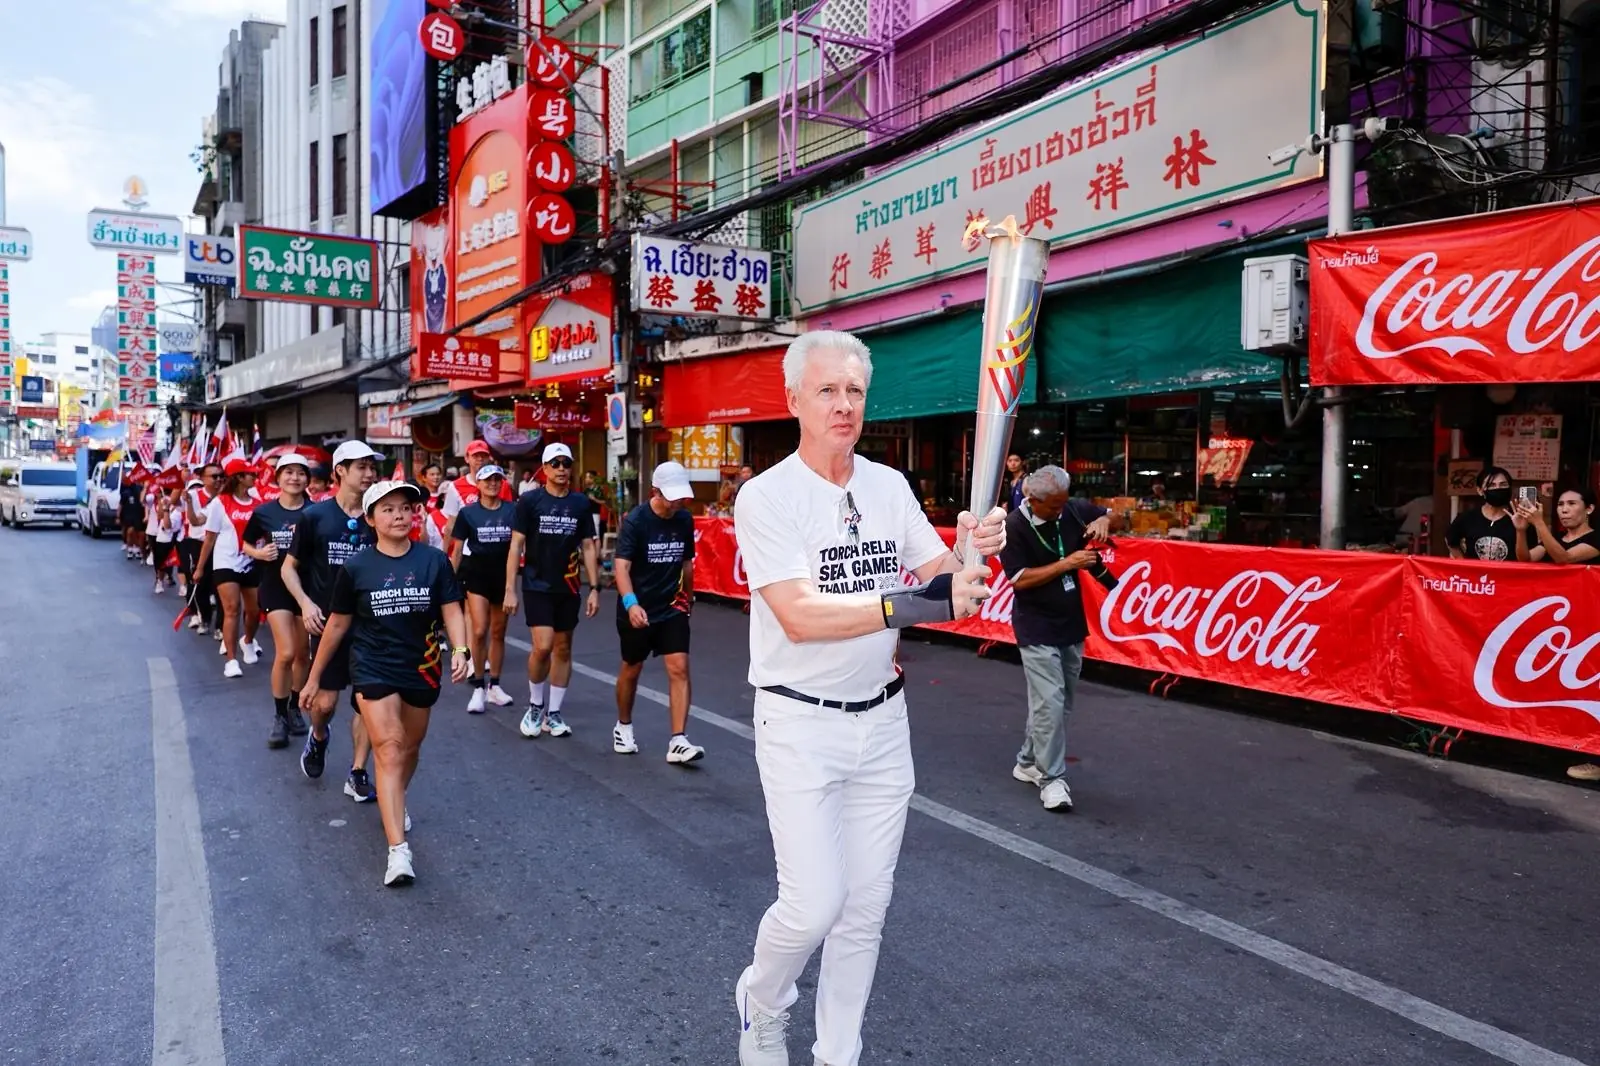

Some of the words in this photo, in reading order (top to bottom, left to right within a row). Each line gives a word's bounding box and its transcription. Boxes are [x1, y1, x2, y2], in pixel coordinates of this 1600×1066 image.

[427, 17, 457, 56] 包
[856, 176, 958, 234] ห้างขายยา
[189, 240, 235, 265] ttb
[248, 236, 370, 282] ฉ.มั่นคง
[205, 275, 228, 285] 1428
[163, 330, 194, 340] GOLD
[328, 542, 354, 551] TORCH
[819, 545, 860, 563] TORCH
[862, 540, 898, 556] RELAY
[819, 562, 850, 582] SEA
[851, 556, 899, 577] GAMES
[370, 589, 401, 600] TORCH
[403, 587, 430, 597] RELAY
[818, 578, 875, 595] THAILAND
[1418, 574, 1496, 596] ไทยน้ำทิพย์
[373, 605, 410, 617] THAILAND
[1100, 560, 1342, 673] Coca-Cola
